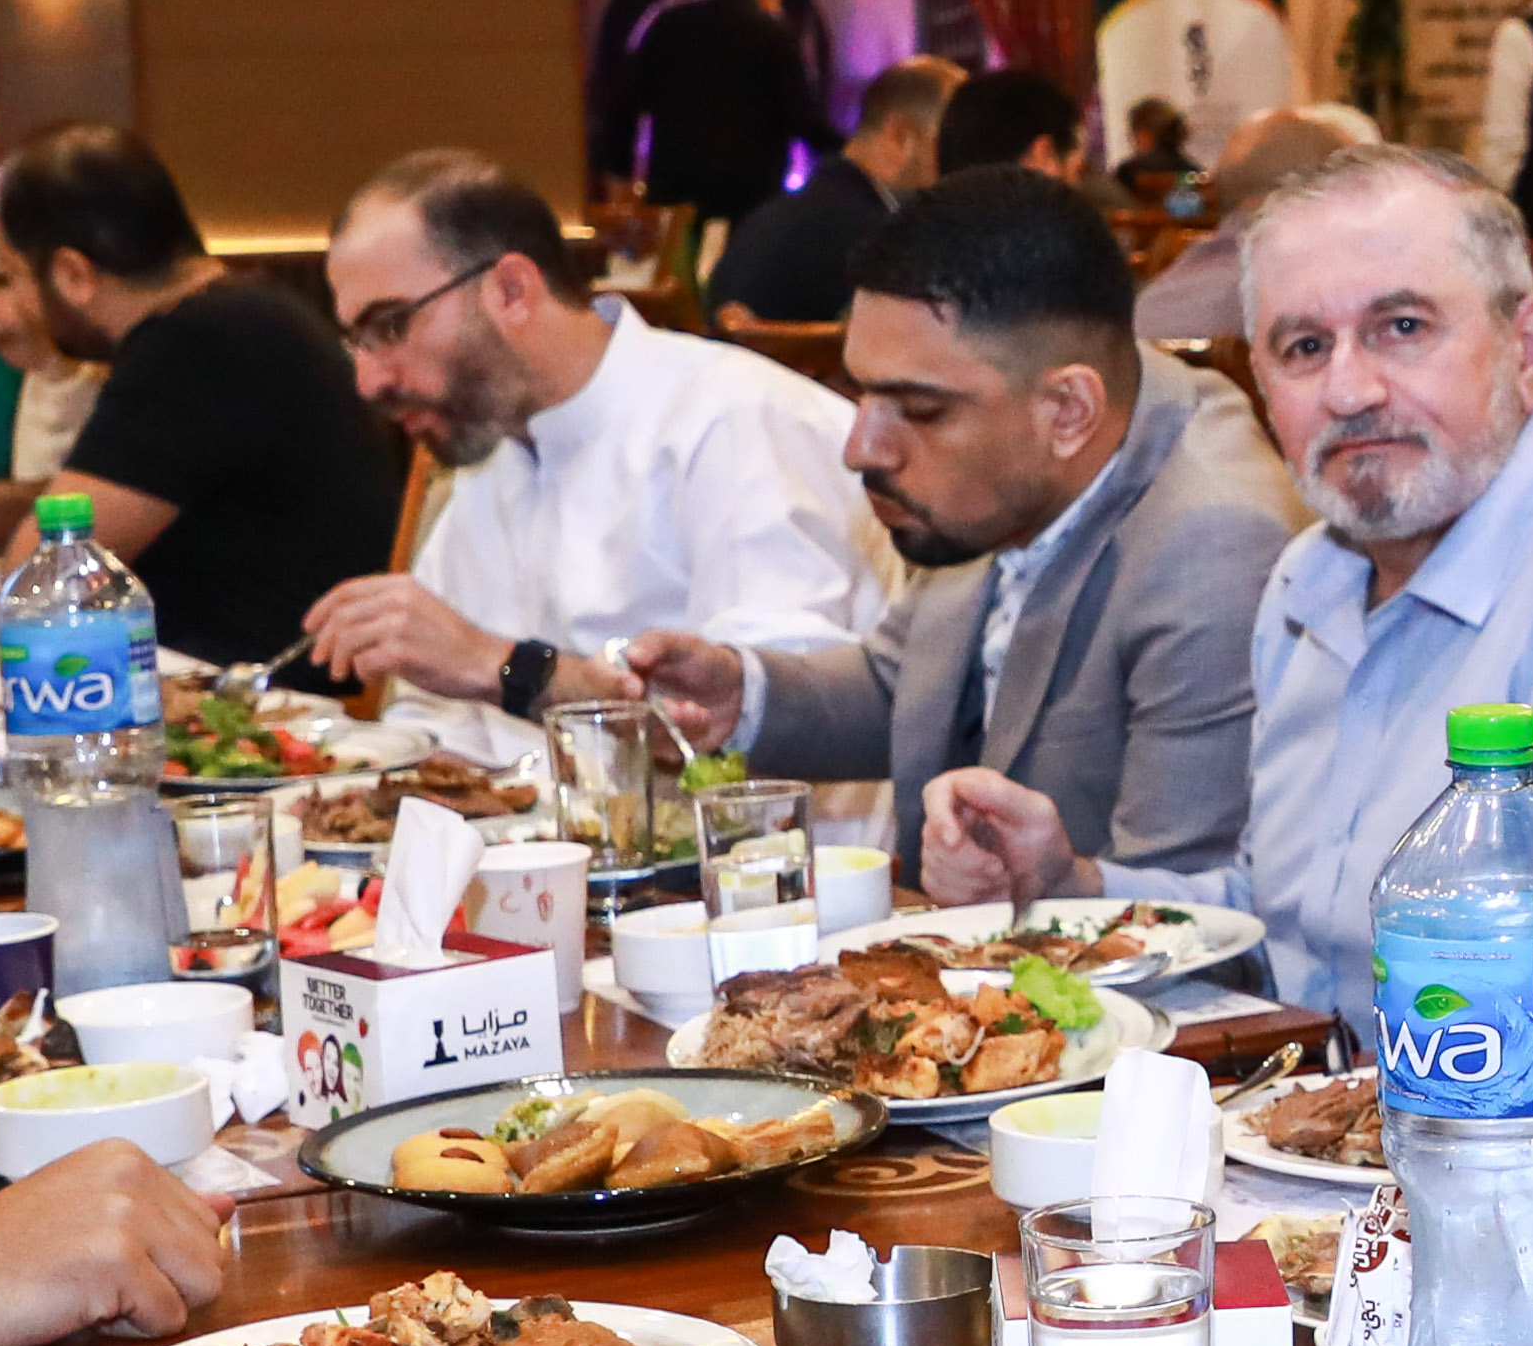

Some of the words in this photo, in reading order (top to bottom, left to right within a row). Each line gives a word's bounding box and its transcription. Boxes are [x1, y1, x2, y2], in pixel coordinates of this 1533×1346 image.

[306, 976, 347, 1001] BETTER
[301, 992, 354, 1021] TOGETHER
[461, 1008, 528, 1039] مزايا
[465, 1035, 531, 1060] MAZAYA
